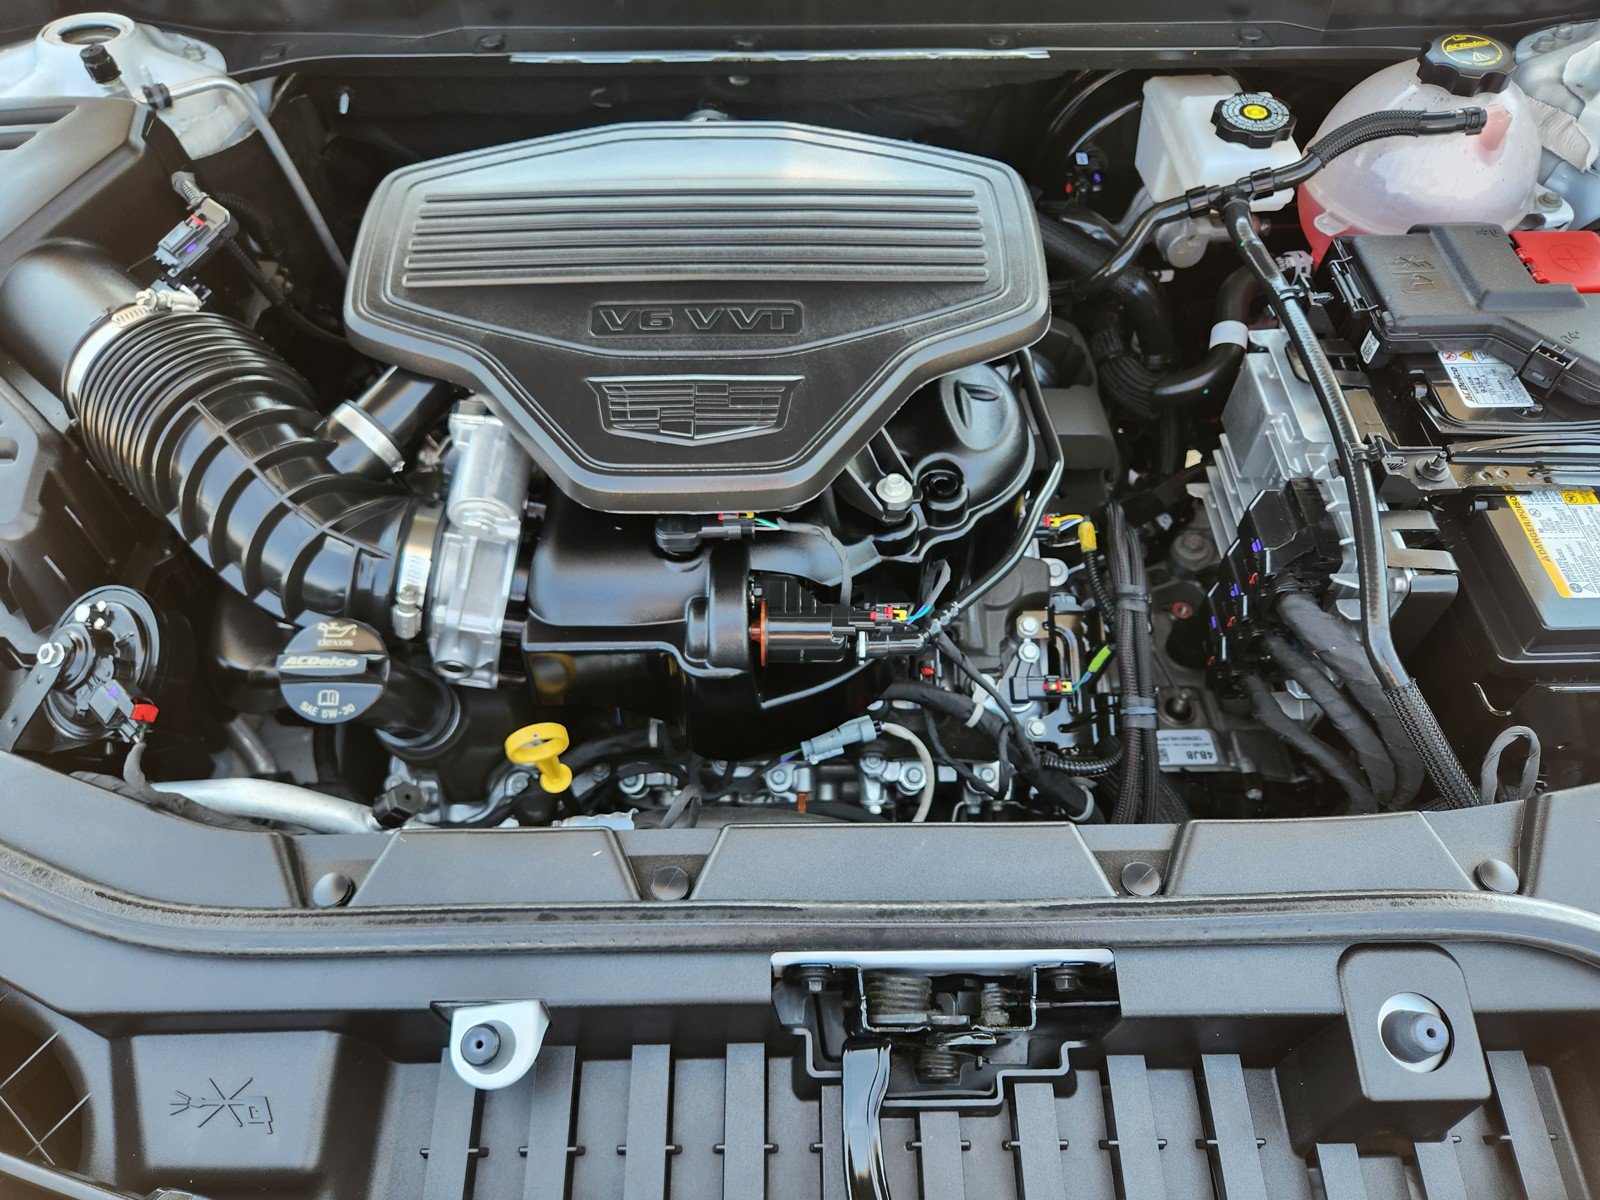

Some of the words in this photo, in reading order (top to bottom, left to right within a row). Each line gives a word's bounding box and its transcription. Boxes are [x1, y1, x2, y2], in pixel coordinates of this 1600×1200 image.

[600, 308, 674, 331] V6
[684, 307, 795, 330] VVT
[1450, 366, 1475, 402] ACDelco
[282, 655, 359, 668] ACDelco
[300, 700, 319, 716] SAE
[321, 703, 356, 719] 5W-30
